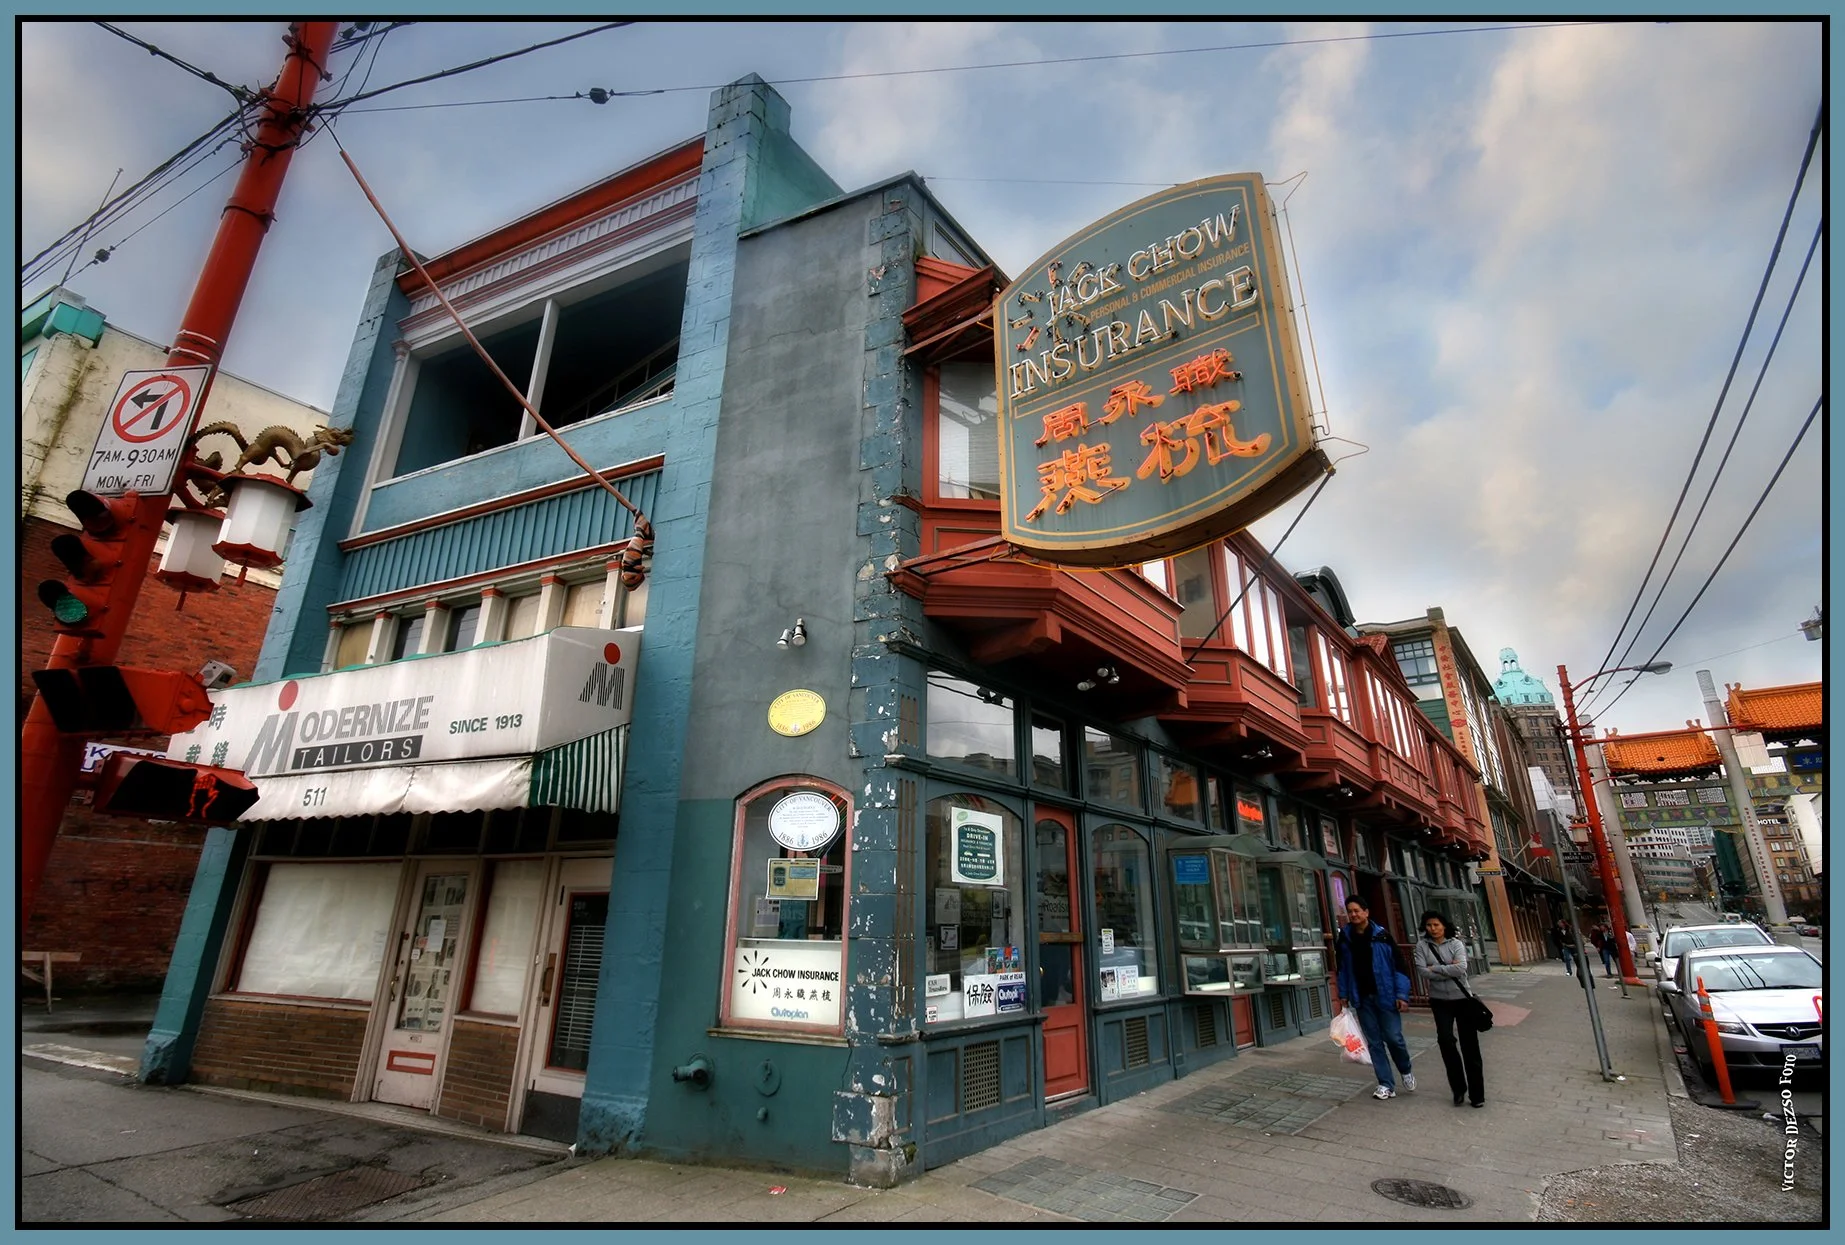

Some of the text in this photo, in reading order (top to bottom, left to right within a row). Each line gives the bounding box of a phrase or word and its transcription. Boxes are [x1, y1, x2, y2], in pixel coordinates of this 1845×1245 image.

[1046, 204, 1241, 327] JACK CHOW
[1089, 243, 1251, 321] PERSONAL & COMMERCIAL INSURANCE
[1009, 265, 1259, 399] INSURANCE
[449, 713, 523, 735] SINCE 1913
[775, 720, 817, 733] 1886 1986
[300, 738, 413, 770] TAILORS
[303, 786, 327, 807] 511
[775, 795, 833, 815] CITY OF VANCOUVER
[1757, 818, 1780, 826] HOTEL
[778, 830, 829, 845] 1886 1986
[752, 968, 839, 981] JACK CHOW INSURANCE
[966, 983, 994, 1007] 保險
